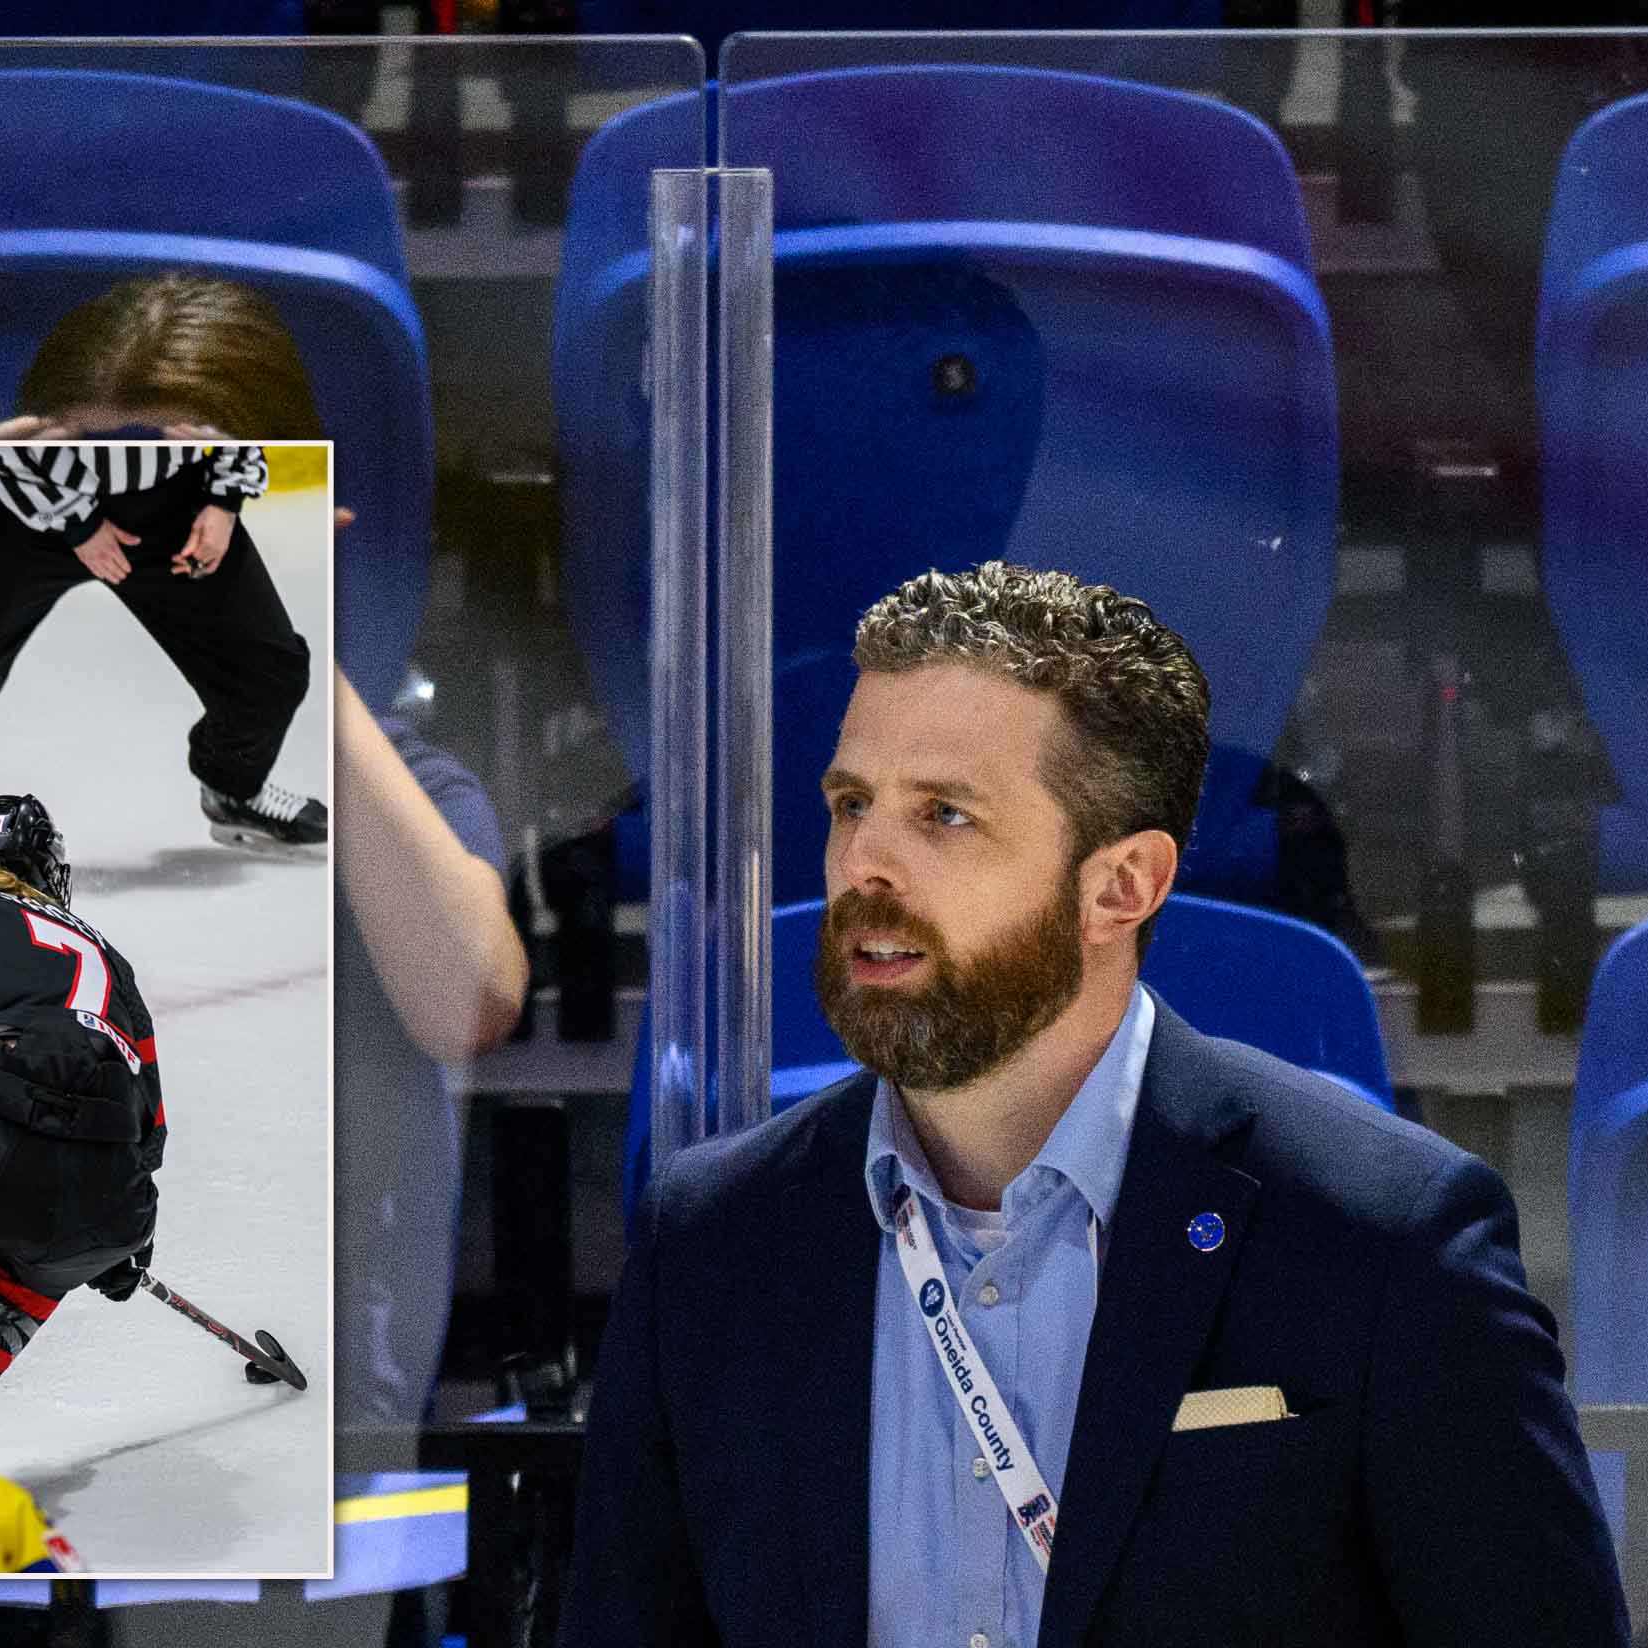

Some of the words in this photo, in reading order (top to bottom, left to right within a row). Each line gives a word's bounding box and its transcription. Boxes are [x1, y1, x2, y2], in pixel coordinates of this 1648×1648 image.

[21, 908, 111, 1019] 7
[935, 1317, 974, 1394] Oneida
[971, 1395, 1014, 1472] County
